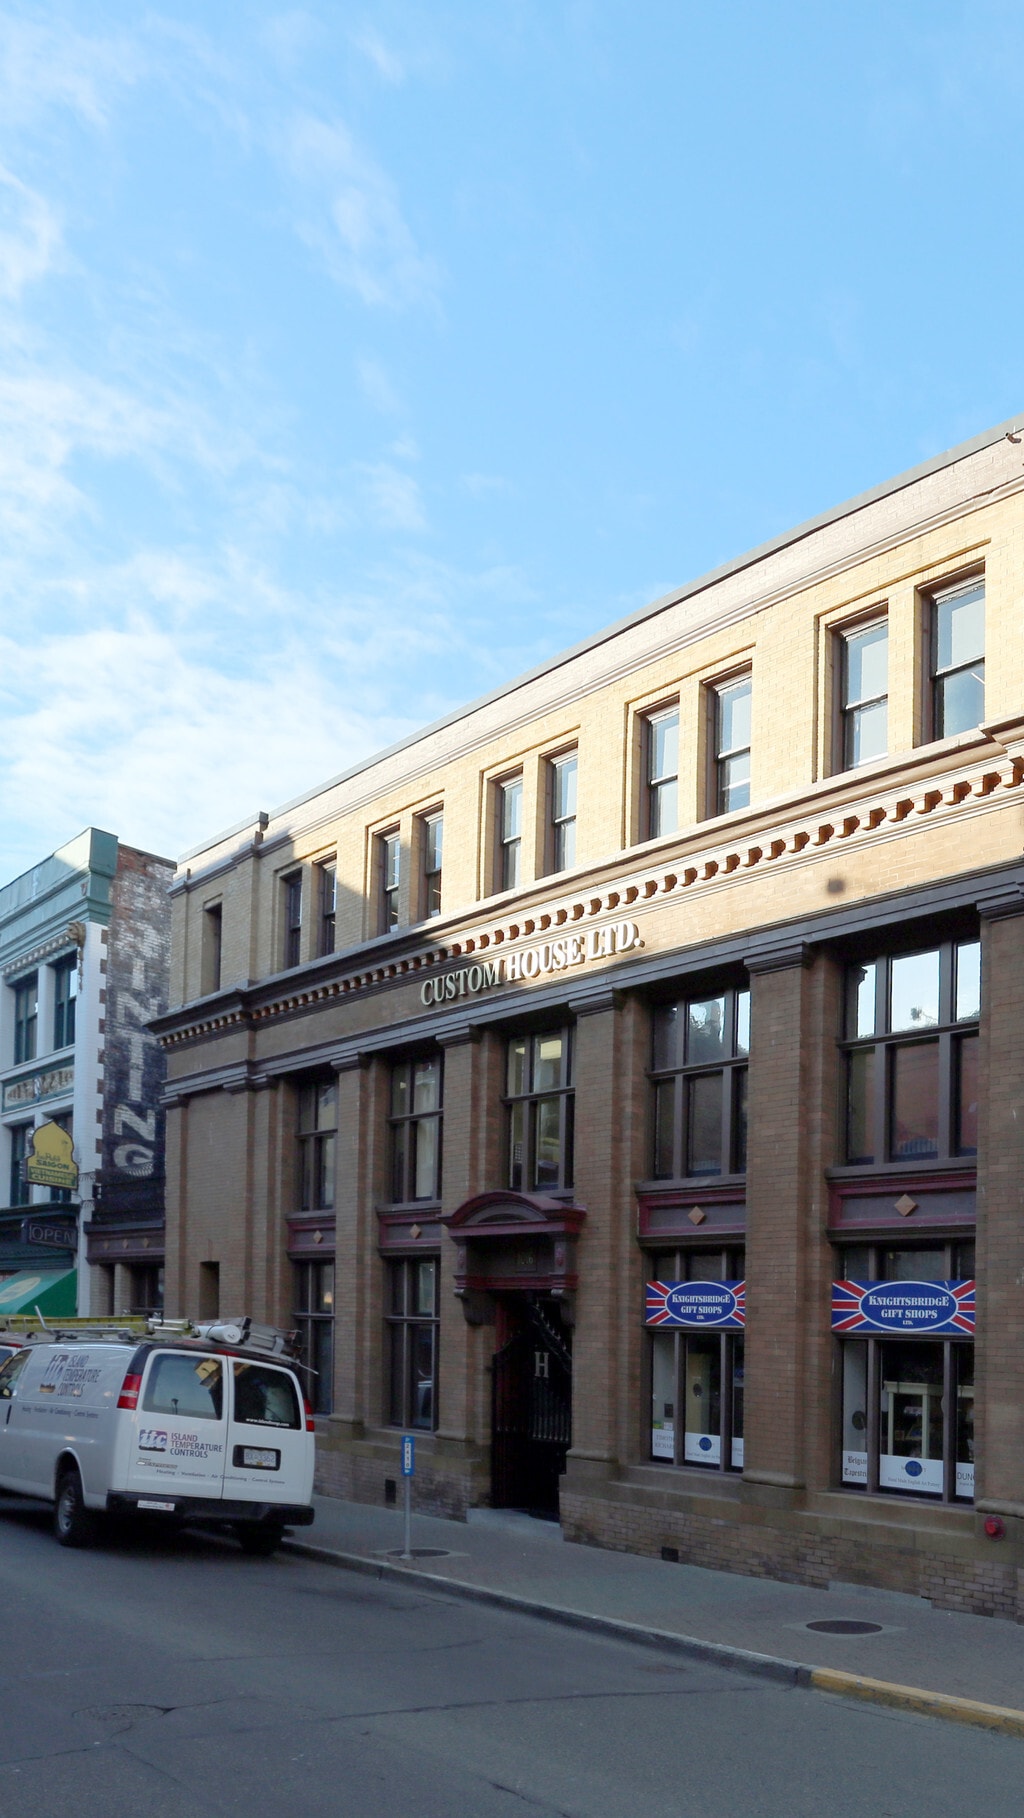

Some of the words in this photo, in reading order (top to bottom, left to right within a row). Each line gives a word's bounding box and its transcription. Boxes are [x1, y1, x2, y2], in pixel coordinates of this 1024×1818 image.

[420, 961, 501, 1007] CUSTOM
[506, 937, 583, 982] HOUSE
[585, 920, 643, 961] LTD.
[36, 1159, 70, 1170] SAIGON
[31, 1173, 74, 1185] CUISINE
[31, 1226, 74, 1243] OPEN
[671, 1293, 731, 1304] KNIGHTSBRIDGE
[868, 1295, 950, 1306] KNIGHTSBRIDGE
[681, 1305, 697, 1314] GIFT
[698, 1306, 722, 1314] SHOPS
[881, 1309, 904, 1318] GIFT
[905, 1309, 938, 1319] SHOPS
[68, 1355, 90, 1368] ISLAND
[62, 1368, 102, 1383] TEMPERATURE
[171, 1432, 198, 1443] ISLAND
[171, 1440, 223, 1453] TEMPERATURE
[170, 1448, 208, 1459] CONTROLS
